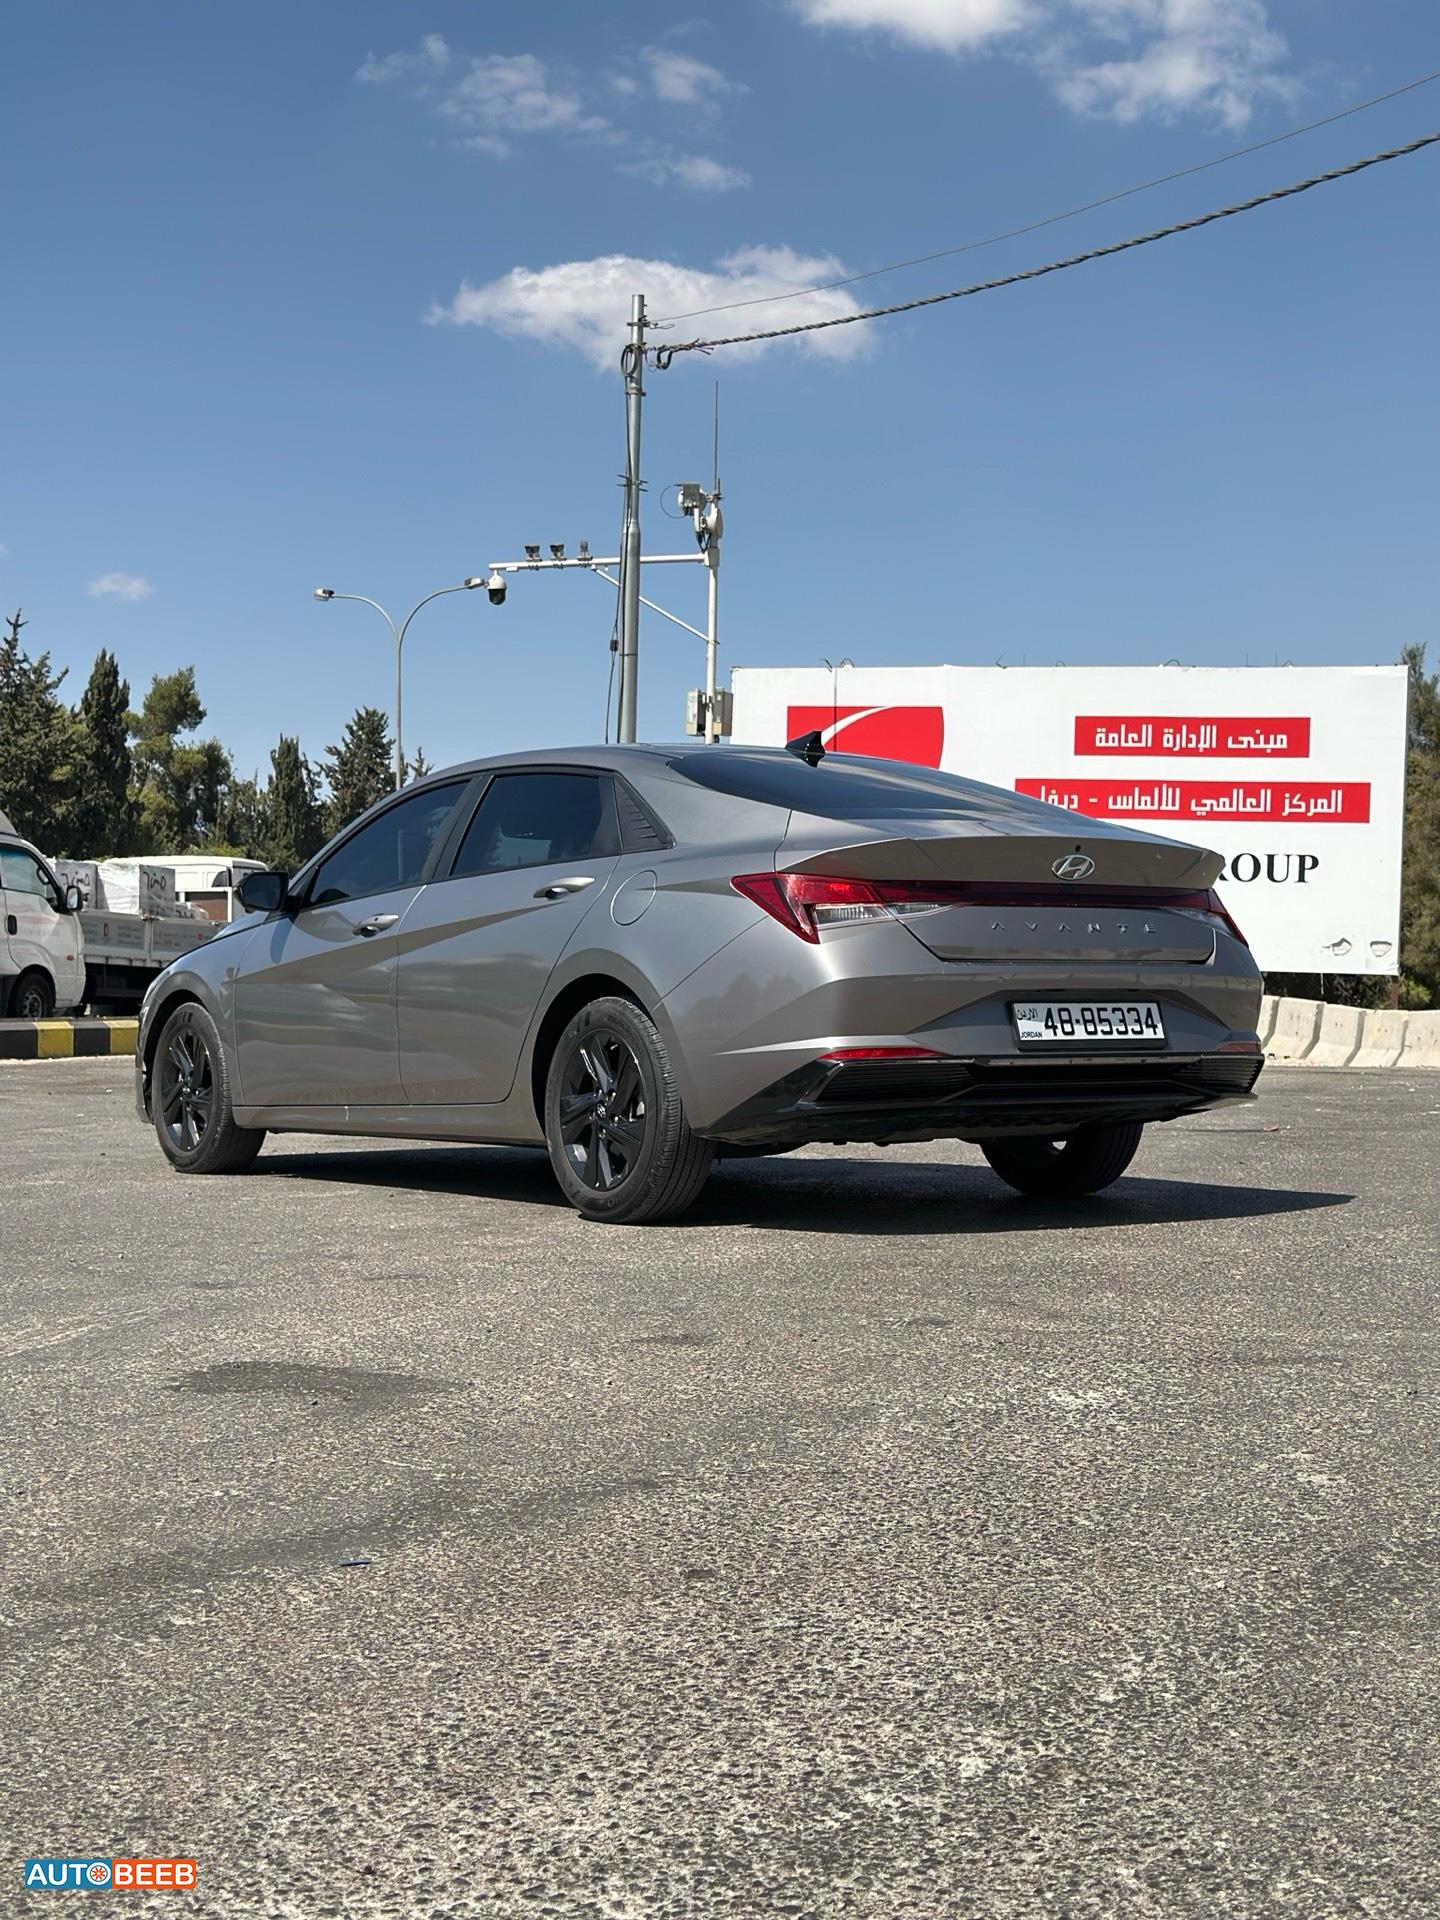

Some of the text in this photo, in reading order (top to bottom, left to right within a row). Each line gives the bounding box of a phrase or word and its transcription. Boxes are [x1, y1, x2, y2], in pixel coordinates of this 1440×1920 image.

[1095, 724, 1288, 753] مبنى الإدارة العامة
[1107, 784, 1181, 811] للألماس
[1190, 788, 1271, 816] العالمي
[1281, 789, 1343, 816] المركز
[1219, 853, 1320, 883] OUP
[991, 920, 1157, 935] AVANTE
[1020, 1031, 1043, 1039] JORDAN
